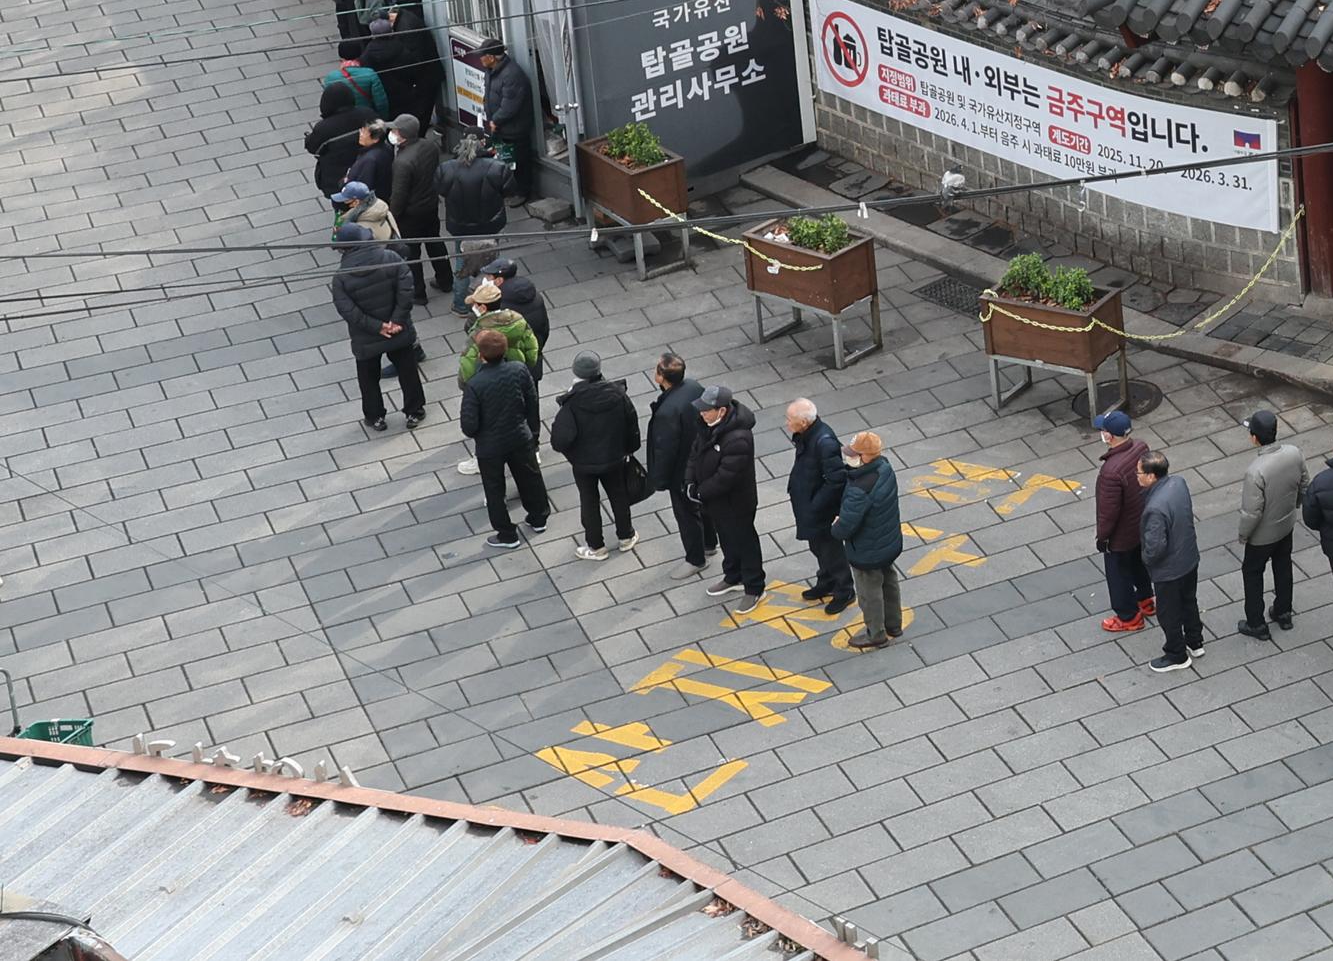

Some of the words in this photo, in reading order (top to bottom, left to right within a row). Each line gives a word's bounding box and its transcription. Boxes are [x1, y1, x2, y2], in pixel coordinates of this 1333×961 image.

[631, 58, 766, 122] 관리사무소
[640, 21, 749, 80] 탑골공원
[876, 26, 948, 77] 탑골공원
[1047, 85, 1208, 153] 금주구역입니다.
[881, 67, 914, 92] 지정범위
[920, 80, 955, 107] 탑골공원
[957, 91, 966, 110] 및
[969, 98, 1041, 137] 국가유산지정구역
[1051, 127, 1090, 154] 계도기간
[882, 88, 908, 110] 과태료
[909, 96, 928, 116] 부과
[1001, 131, 1019, 151] 음주
[1022, 140, 1031, 155] 시
[1034, 140, 1062, 164] 과태료
[1064, 153, 1095, 176] 10만원
